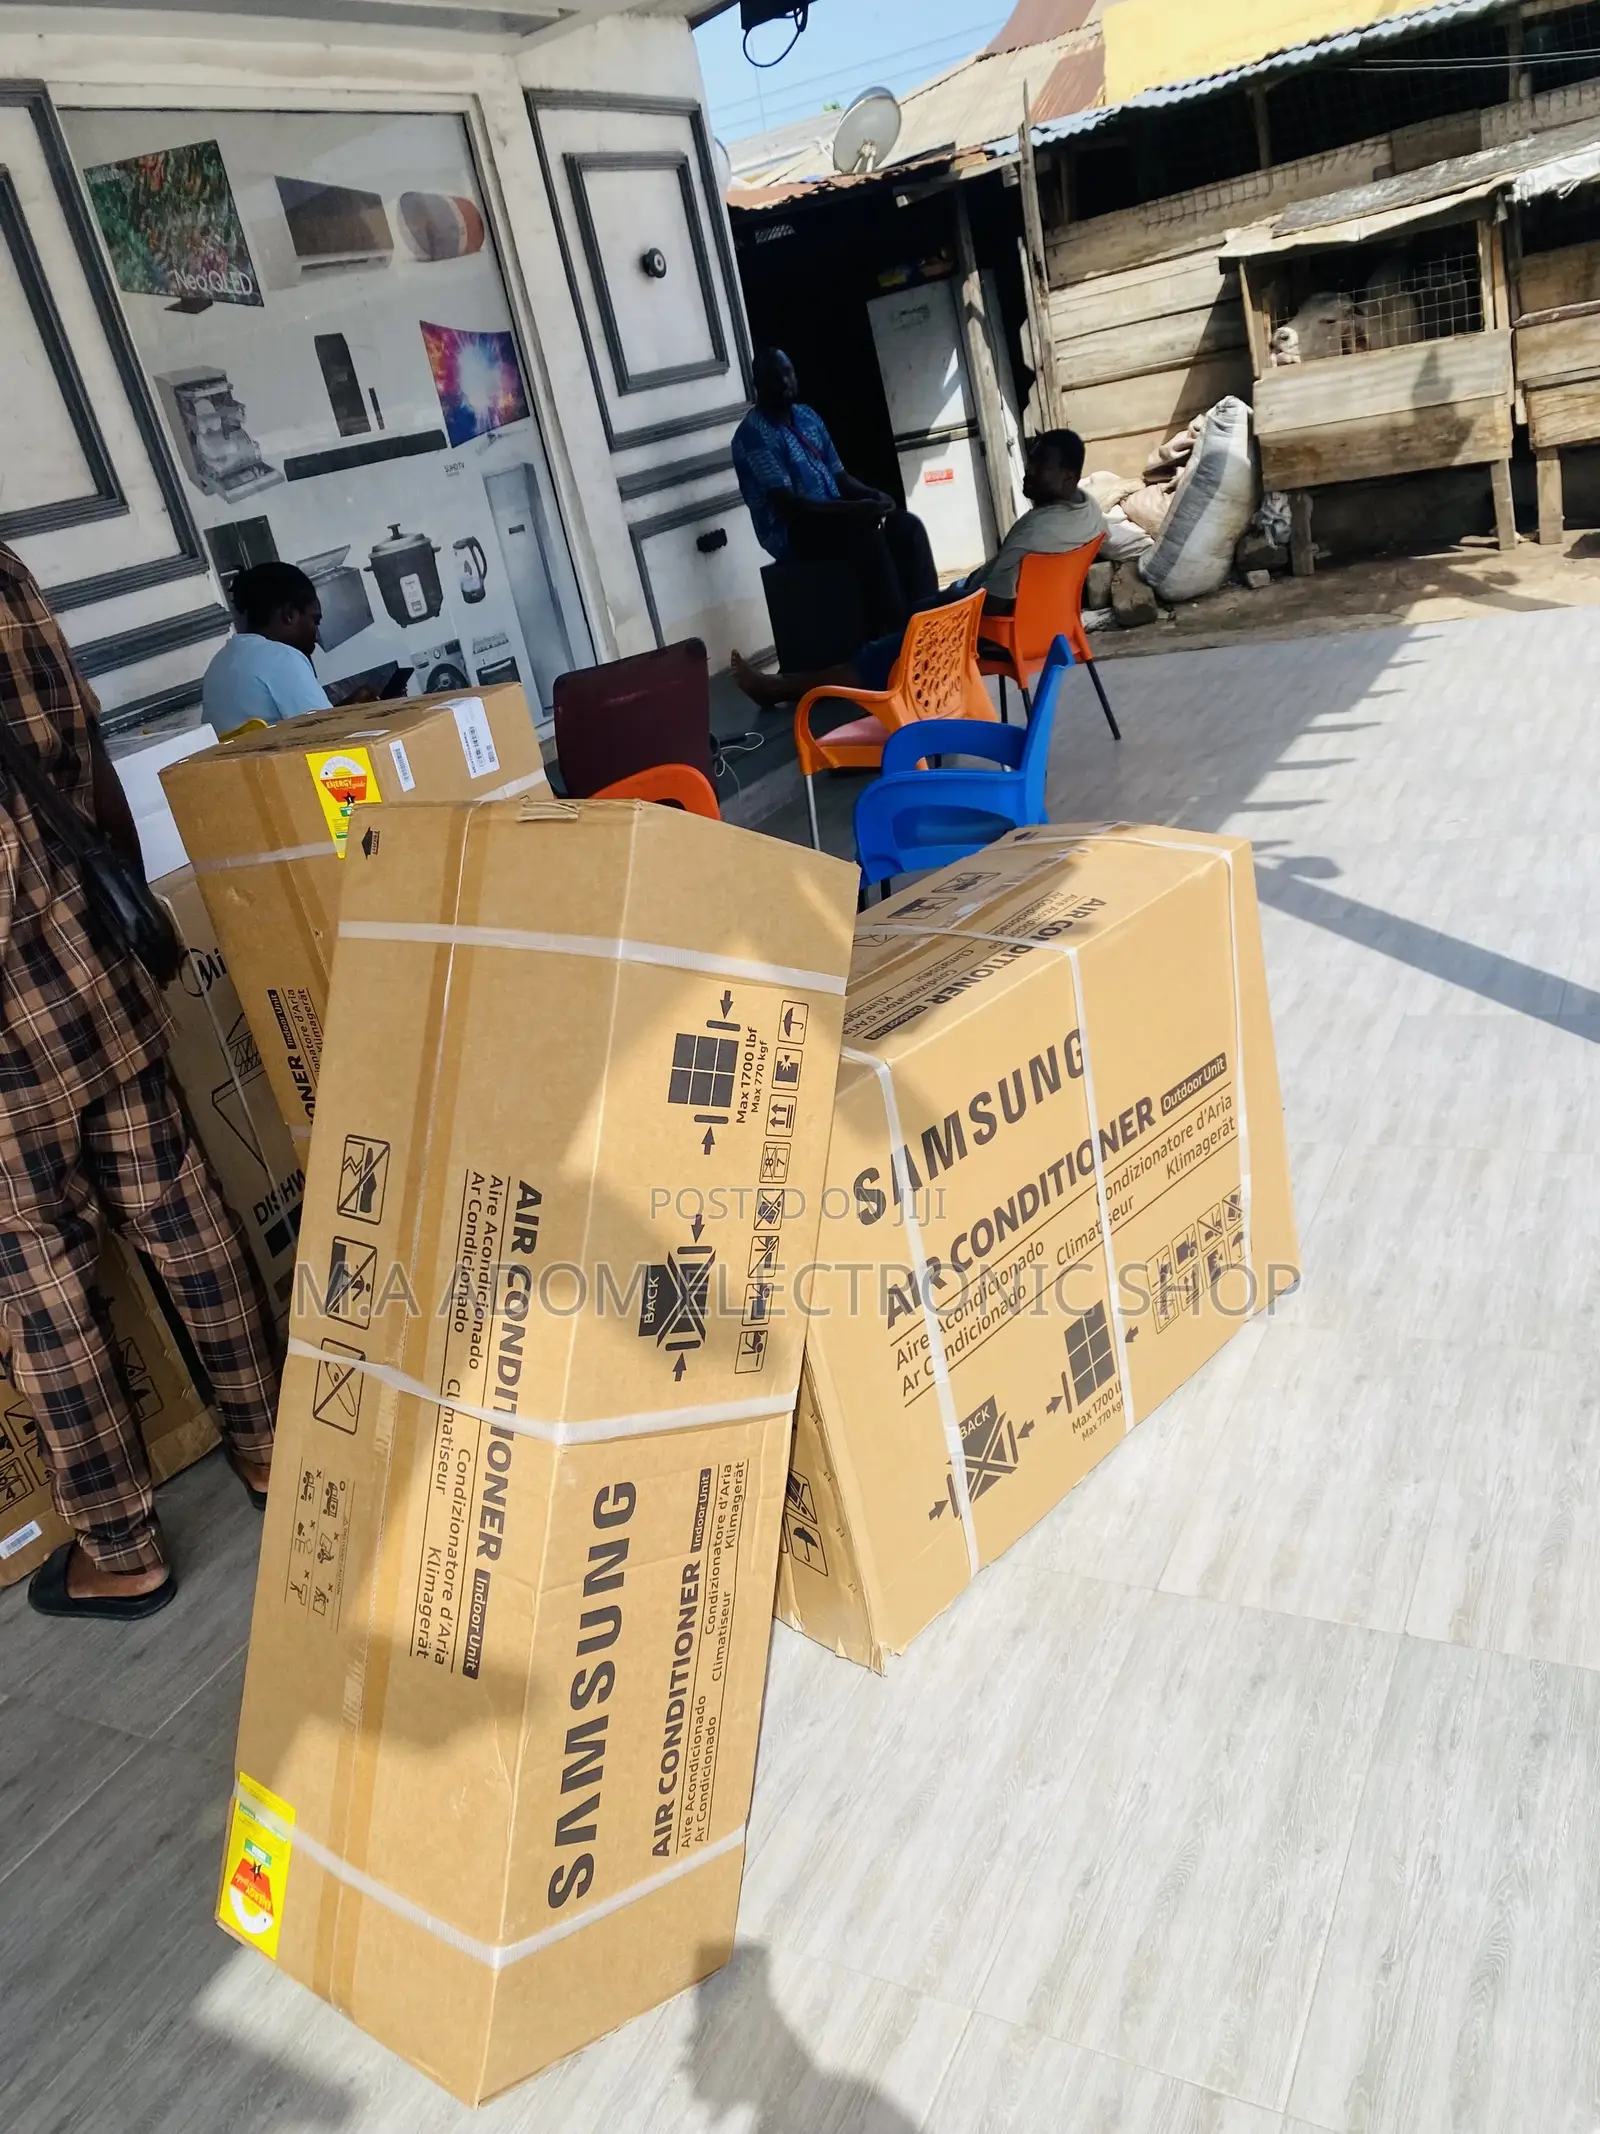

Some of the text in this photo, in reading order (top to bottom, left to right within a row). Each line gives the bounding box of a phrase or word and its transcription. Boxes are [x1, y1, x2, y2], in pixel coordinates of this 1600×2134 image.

[171, 269, 253, 294] Neo QLED
[326, 779, 353, 789] ENERGY
[1064, 897, 1107, 919] AIR
[271, 993, 295, 1049] Indoor Unit
[287, 988, 321, 1076] ionatore d'Aria
[842, 995, 894, 1025] Klimager
[736, 1026, 759, 1124] Max 1700 lbf
[750, 1041, 769, 1113] Max 770 kgf
[852, 1028, 1086, 1226] SAMSUNG
[253, 1168, 306, 1227] DISHW
[511, 1180, 543, 1255] AIR
[887, 1056, 1225, 1330] AIR CONDITIONER Outdoor Unit
[897, 1333, 930, 1371] Aire
[1197, 1095, 1232, 1131] d'Aria
[903, 1117, 1236, 1397] Ar Cndicionado Climatseur Klimagerät
[644, 1276, 660, 1324] BACK
[416, 1171, 485, 1660] Ar Condicionado Clmatiseur Klimagerät
[434, 1174, 504, 1666] Aire Acondicionado Condizionatore d'Aria
[960, 1404, 992, 1440] BACK
[1072, 1388, 1114, 1434] Max 1700
[1082, 1422, 1098, 1442] Max
[1097, 1409, 1111, 1426] 770
[469, 1578, 488, 1635] Indoor
[465, 1634, 482, 1671] Unit
[652, 1473, 711, 1857] AIR CONDITIONER Indoor Unit
[680, 1463, 733, 1848] Aire Acondicionado Condizionatore d'Aria
[694, 1461, 745, 1843] Ar Condicionado Climatiseur Klimagerät
[547, 1480, 637, 1910] SAMSUNG
